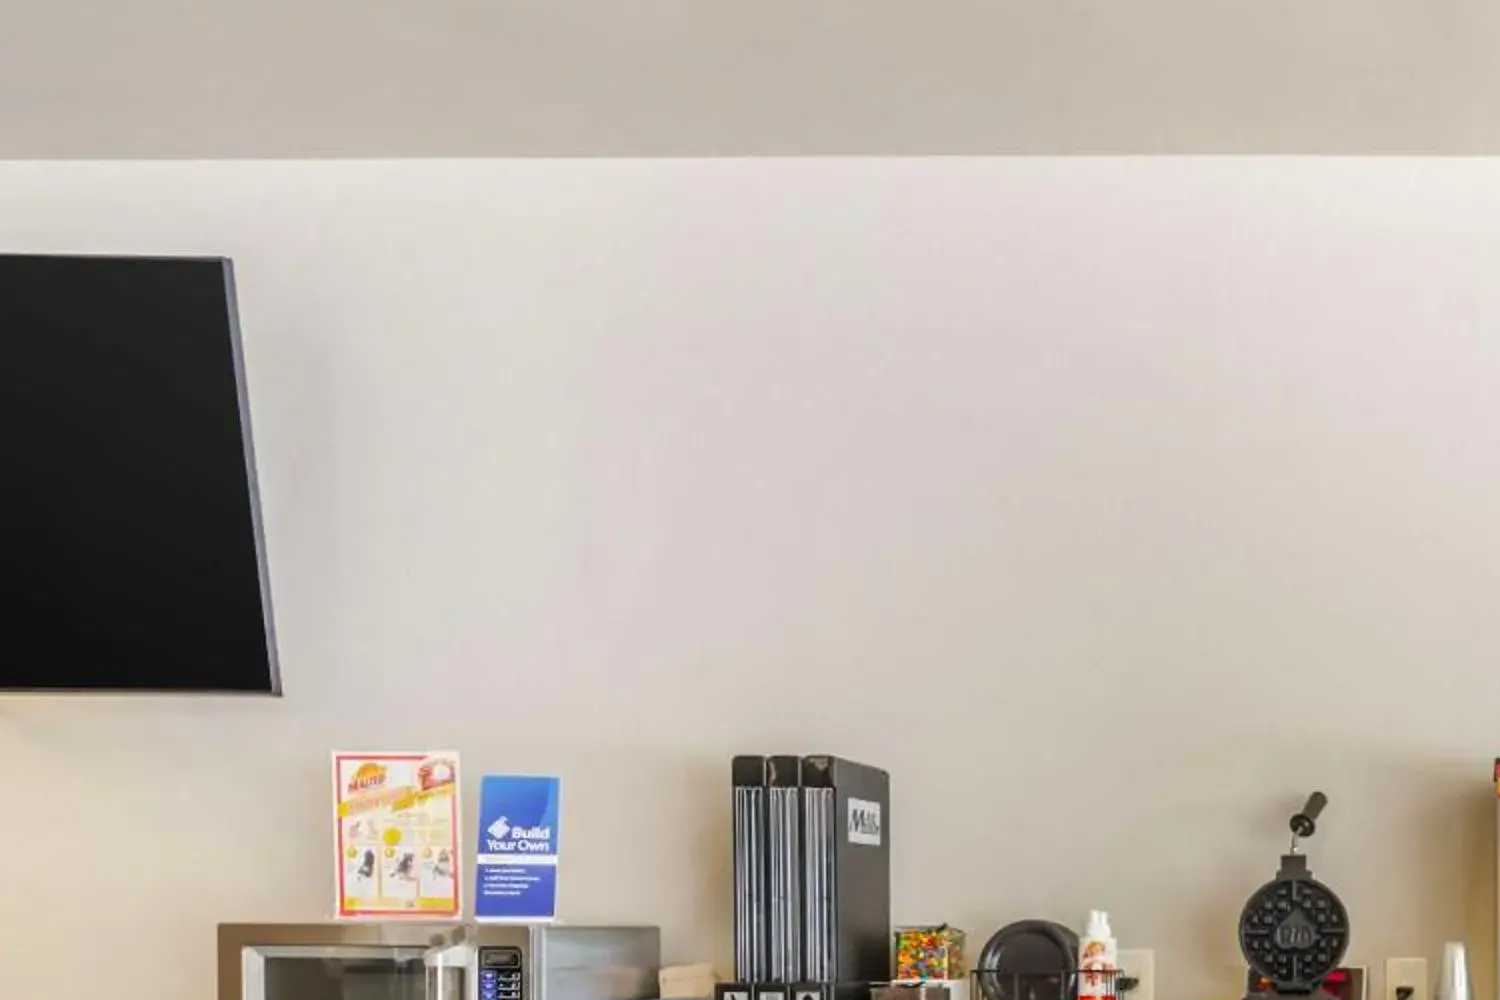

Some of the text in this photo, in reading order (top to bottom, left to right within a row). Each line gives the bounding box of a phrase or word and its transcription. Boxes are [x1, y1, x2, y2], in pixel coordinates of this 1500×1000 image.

[511, 826, 550, 839] Build
[486, 839, 549, 851] Your Own
